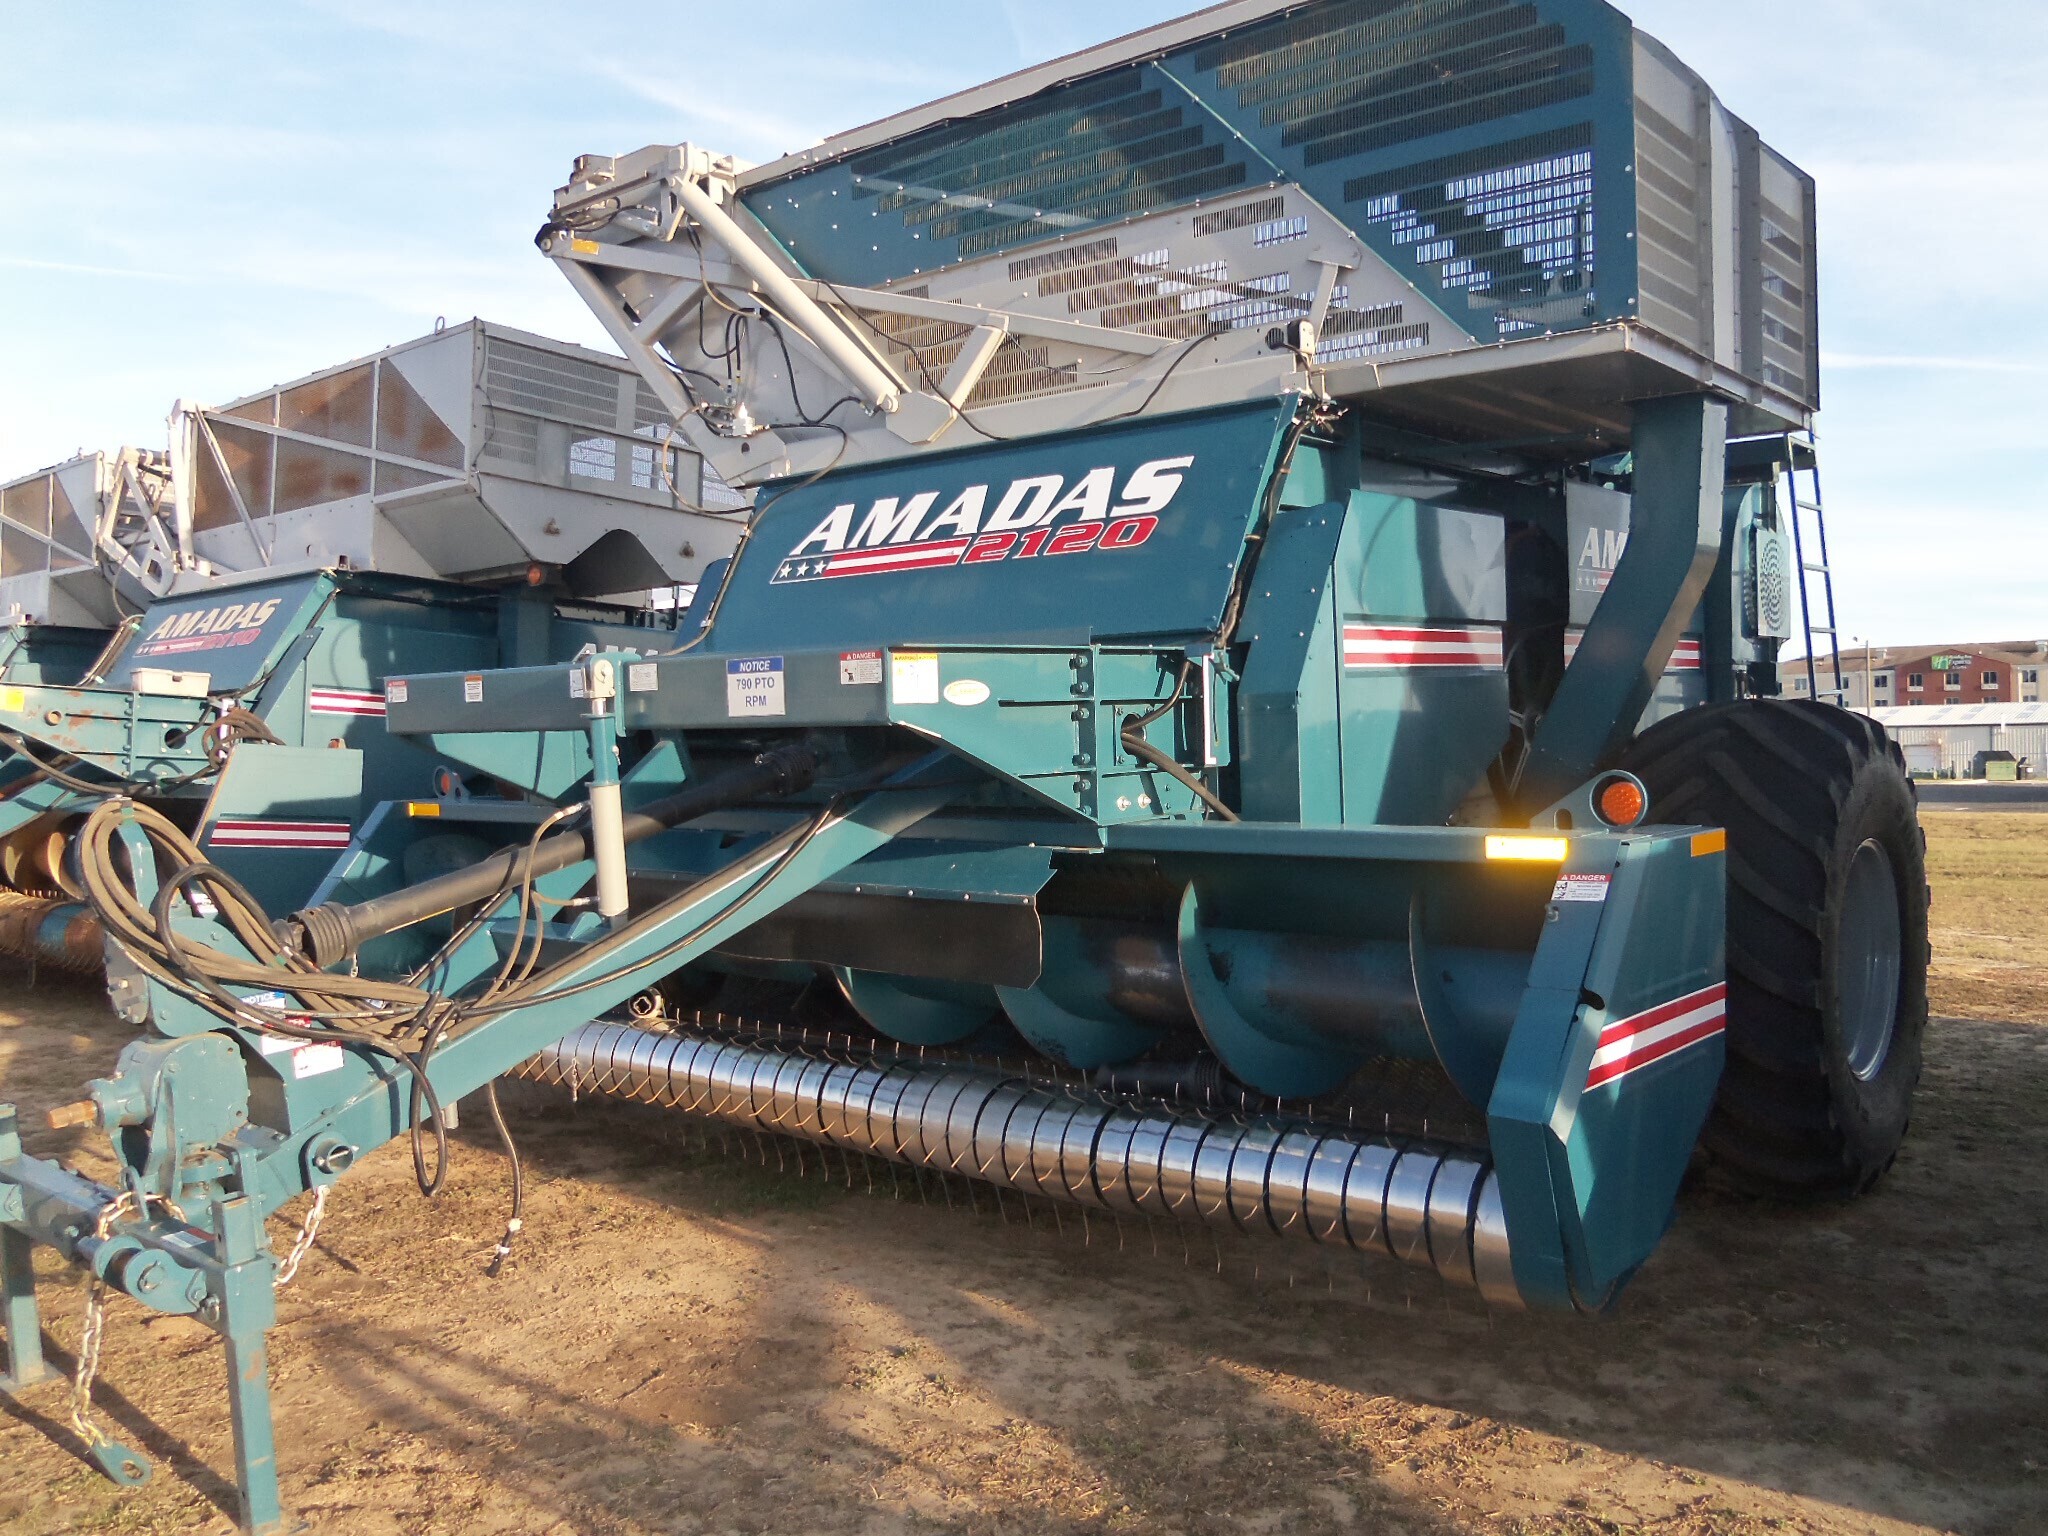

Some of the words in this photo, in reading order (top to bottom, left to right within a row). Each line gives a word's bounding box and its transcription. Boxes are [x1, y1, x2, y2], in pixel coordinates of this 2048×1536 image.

[789, 456, 1194, 554] AMADAS
[961, 515, 1159, 565] 2120
[147, 598, 282, 641] AMADAS
[852, 652, 876, 660] DANGER
[739, 660, 771, 672] NOTICE
[736, 678, 752, 690] 790
[755, 676, 775, 689] PTO
[745, 695, 767, 707] RPM
